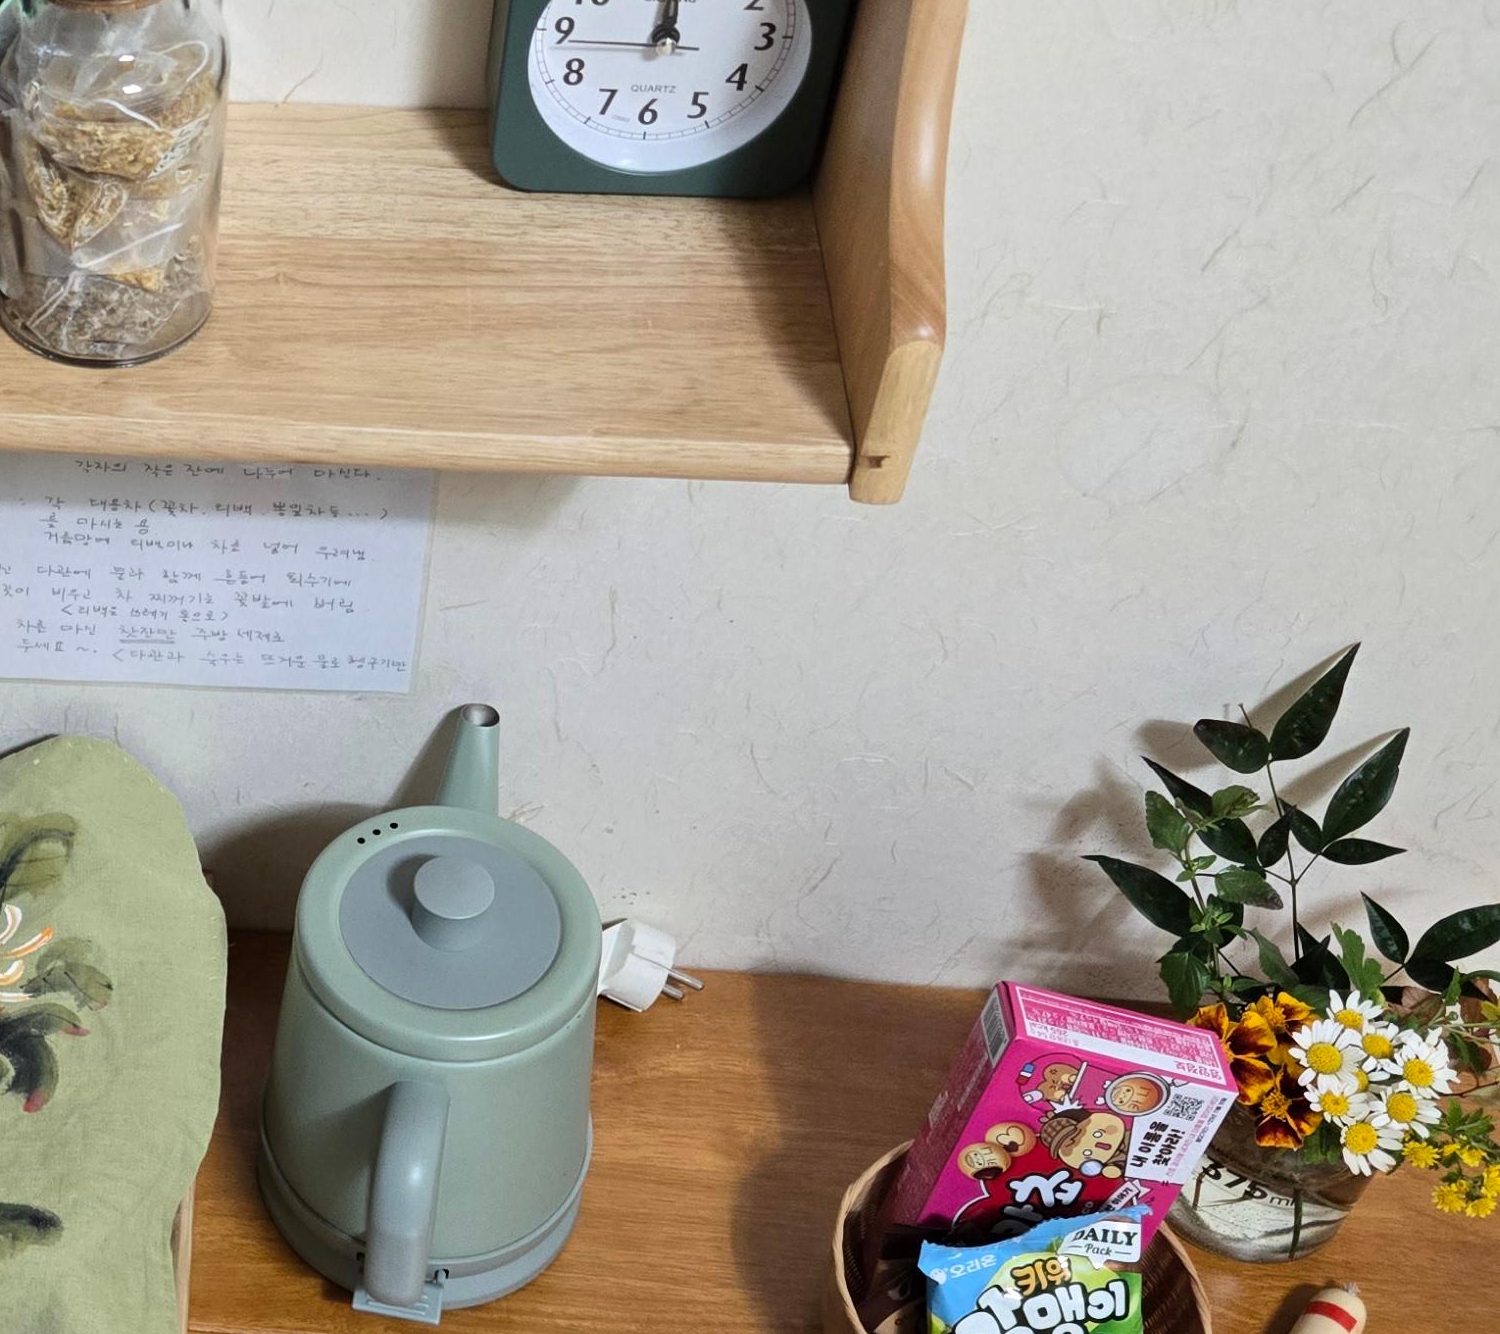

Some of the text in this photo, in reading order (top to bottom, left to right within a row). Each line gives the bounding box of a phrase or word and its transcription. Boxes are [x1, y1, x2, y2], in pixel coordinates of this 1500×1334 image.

[555, 16, 575, 45] 9
[754, 21, 776, 51] 3
[562, 58, 585, 85] 8
[725, 62, 749, 91] 4
[598, 88, 618, 115] 7
[631, 83, 677, 95] QUARTZ
[637, 98, 658, 125] 6
[687, 91, 709, 119] 5
[144, 464, 173, 477] 작은
[186, 464, 224, 477] 잔에
[243, 467, 293, 480] 나누어
[1129, 1120, 1169, 1167] 내 이름을
[1151, 1128, 1185, 1166] 찾아라!
[1071, 1228, 1138, 1247] DAILY
[1084, 1242, 1113, 1257] Pack
[950, 1254, 997, 1279] 오리온
[1010, 1256, 1072, 1297] 키위
